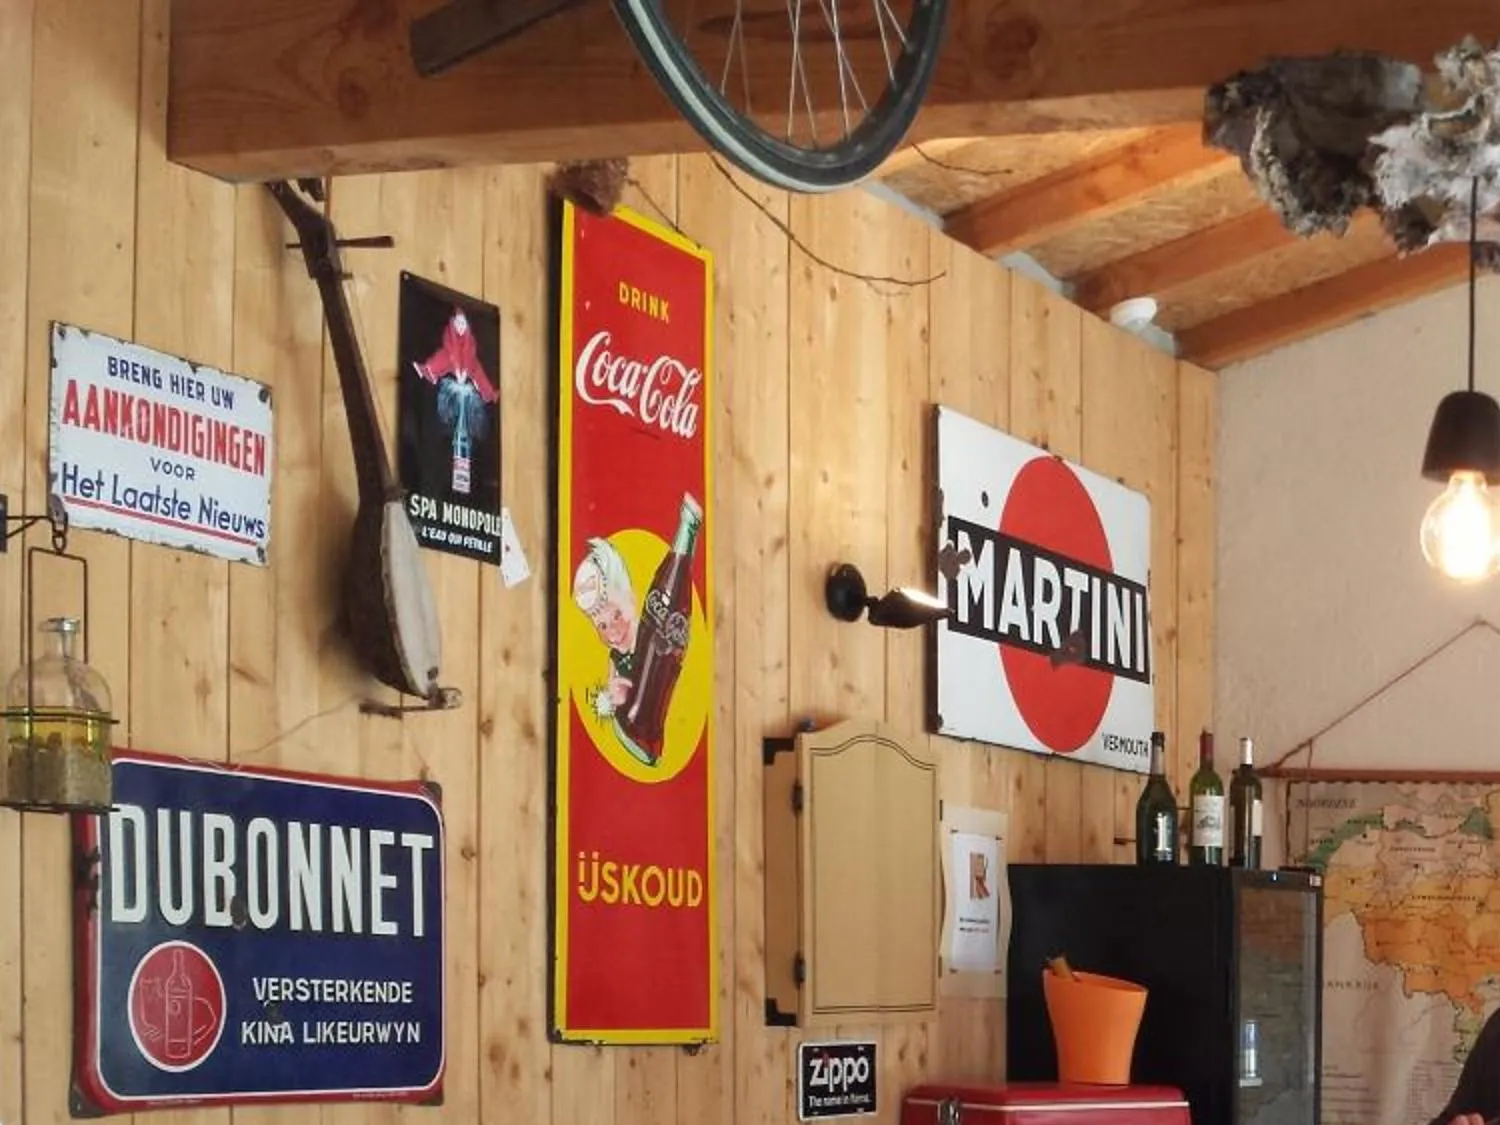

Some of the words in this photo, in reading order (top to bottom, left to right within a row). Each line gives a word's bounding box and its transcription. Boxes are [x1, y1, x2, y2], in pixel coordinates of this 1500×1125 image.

[619, 281, 669, 324] DRINK
[107, 356, 162, 389] BRENG
[170, 373, 205, 403] HIER
[211, 384, 234, 410] UW
[62, 379, 265, 477] AANKONDIGINGEN
[150, 457, 196, 480] VOOR
[62, 462, 104, 500] Het
[112, 474, 191, 520] Laatste
[199, 495, 265, 538] Nieuws
[409, 493, 437, 520] SPA
[443, 502, 502, 537] MONOPOLE
[957, 530, 1146, 672] MARTINI
[1103, 733, 1149, 757] VERMOUTH
[110, 803, 433, 937] DUBONNET
[252, 977, 413, 1004] VERSTERKENDE
[241, 1021, 295, 1044] KINA
[303, 1021, 421, 1044] LIKEURWYN
